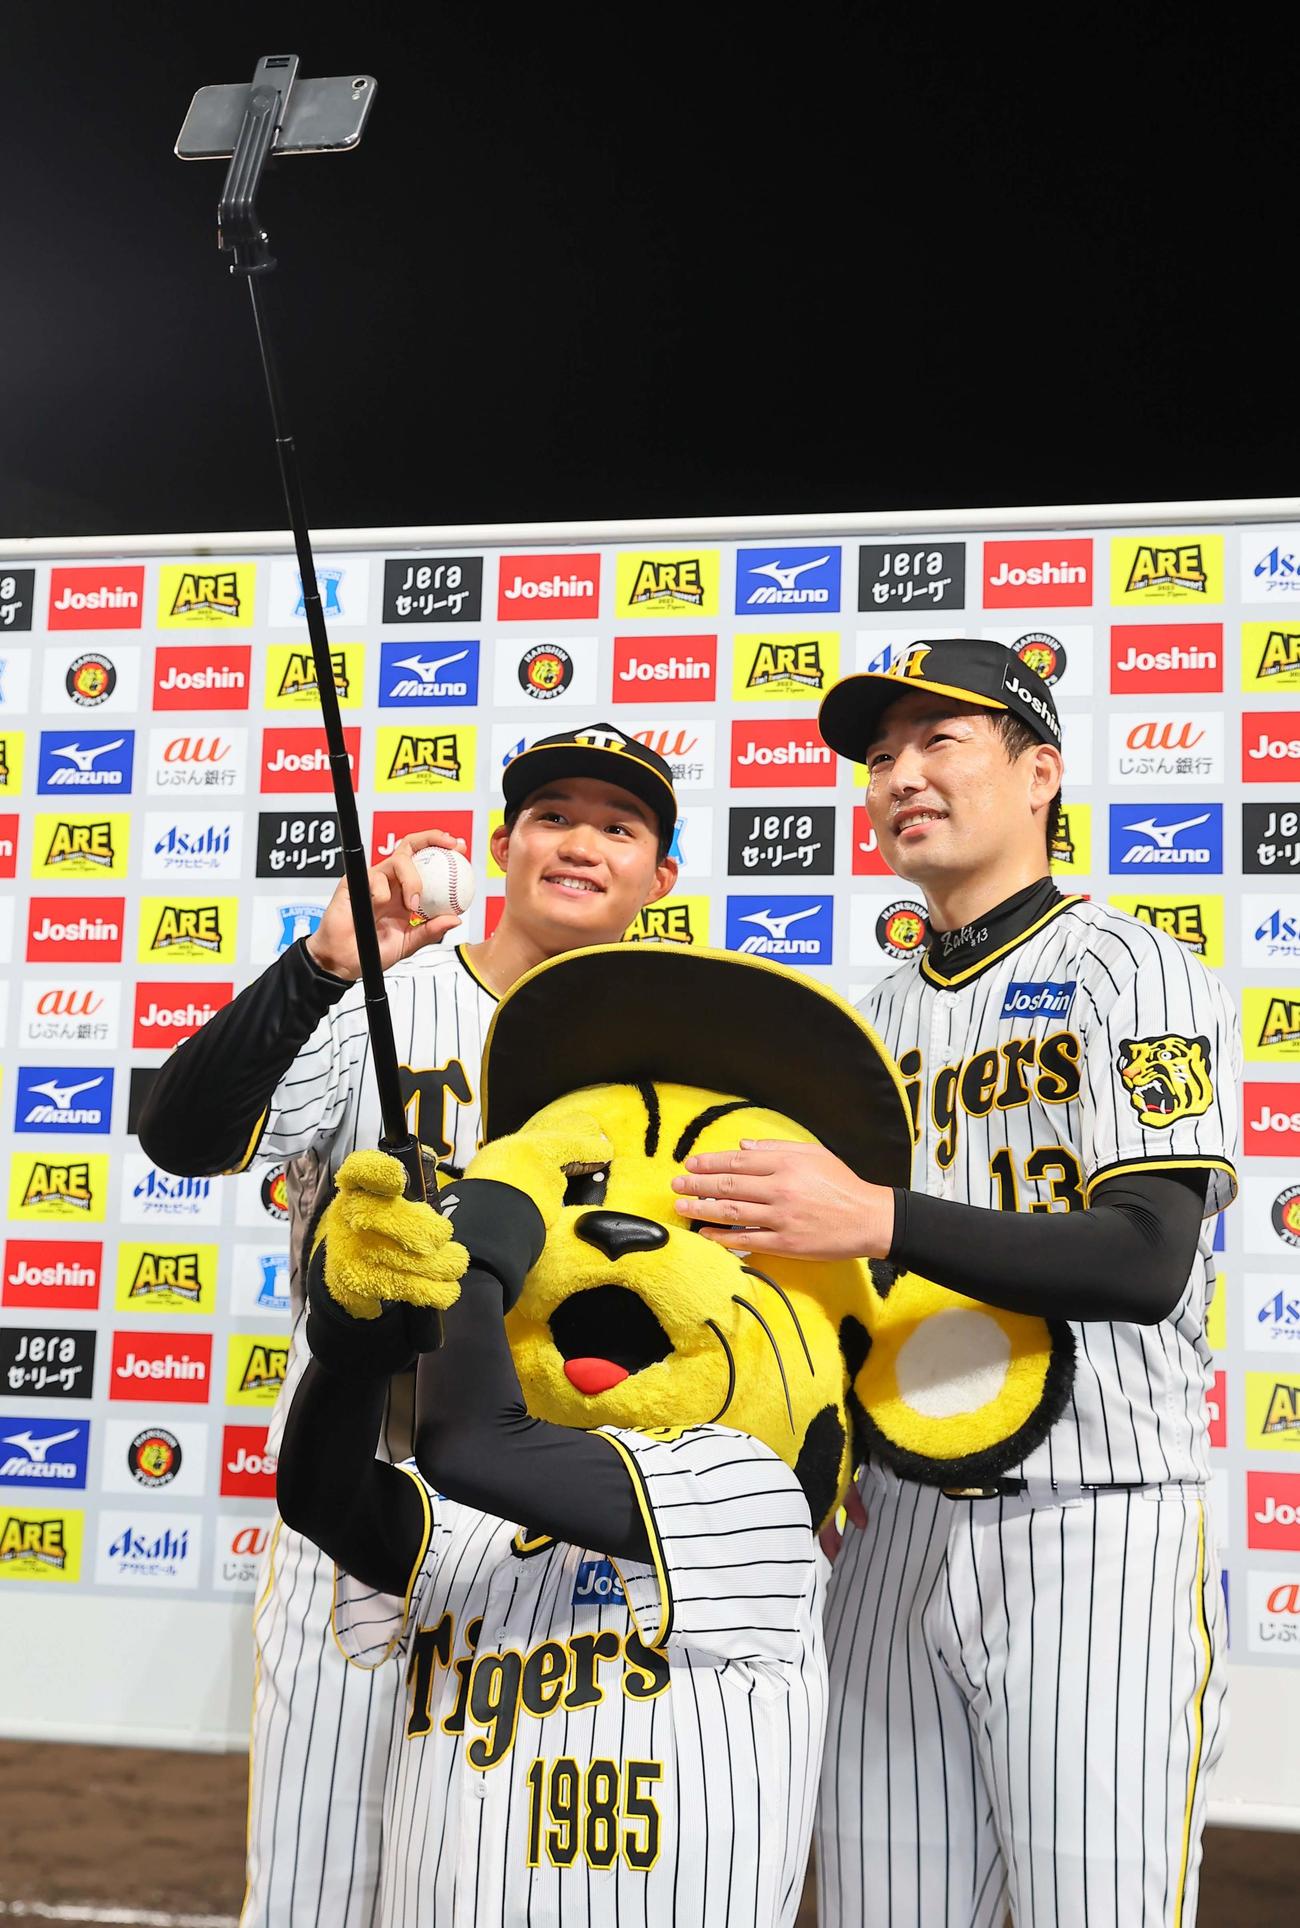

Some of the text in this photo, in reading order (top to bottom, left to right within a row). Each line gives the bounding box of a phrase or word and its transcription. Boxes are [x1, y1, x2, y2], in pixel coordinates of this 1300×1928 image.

[989, 562, 1087, 585] Joshin
[54, 587, 138, 609] Joshin
[504, 576, 594, 598] Joshin
[619, 658, 710, 680] Joshin
[1117, 647, 1217, 670] Joshin
[159, 667, 245, 689] Joshin
[1006, 677, 1061, 740] Joshin
[1126, 722, 1206, 750] au
[1249, 736, 1300, 758] Jos
[163, 737, 230, 762] au
[268, 749, 353, 771] Joshn
[737, 742, 831, 764] Joshin
[157, 770, 235, 785] じぶん銀行
[1120, 758, 1212, 774] じぶん銀行
[154, 826, 230, 854] Asahi
[33, 919, 118, 940] Joshin
[36, 990, 104, 1016] au
[1004, 989, 1070, 1012] Joshin
[30, 1024, 107, 1039] じぶん銀行
[898, 1030, 1081, 1170] igers
[989, 1145, 1089, 1214] 13
[9, 1262, 96, 1286] Joshin
[116, 1355, 205, 1379] Joshin
[228, 1449, 277, 1474] Jos
[107, 1527, 188, 1559] Asahi
[577, 1561, 625, 1596] Jos
[404, 1611, 672, 1772] Tigers
[526, 1756, 664, 1872] 1985
